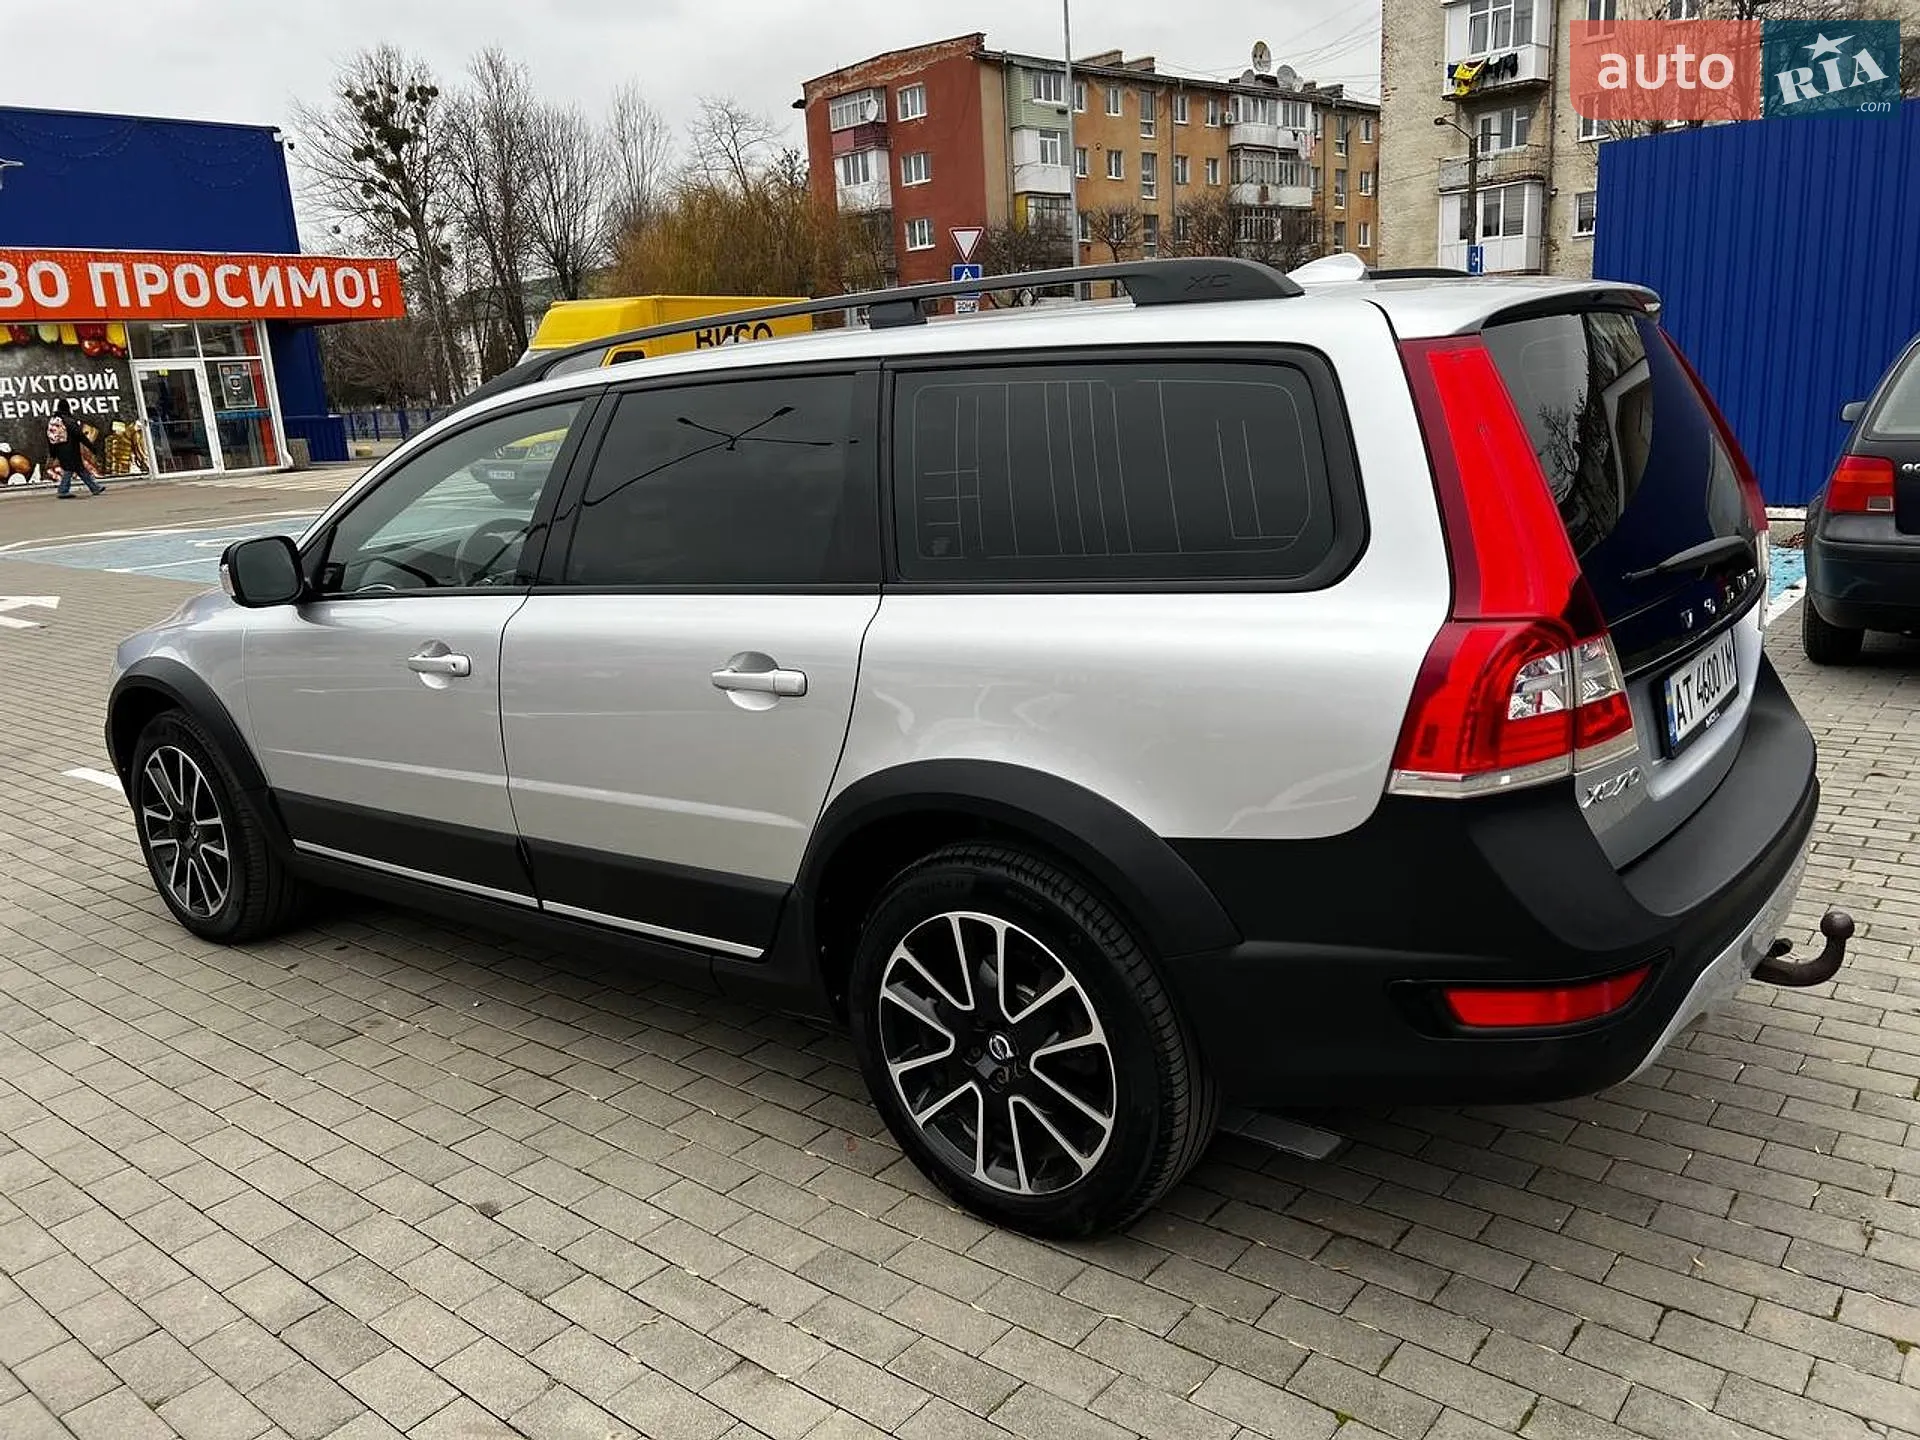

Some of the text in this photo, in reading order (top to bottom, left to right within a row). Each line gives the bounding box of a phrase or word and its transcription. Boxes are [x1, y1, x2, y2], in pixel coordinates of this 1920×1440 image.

[88, 261, 382, 309] ПРОСИМО!
[0, 396, 121, 420] ЕРМРКЕТ
[1675, 673, 1694, 732] AT
